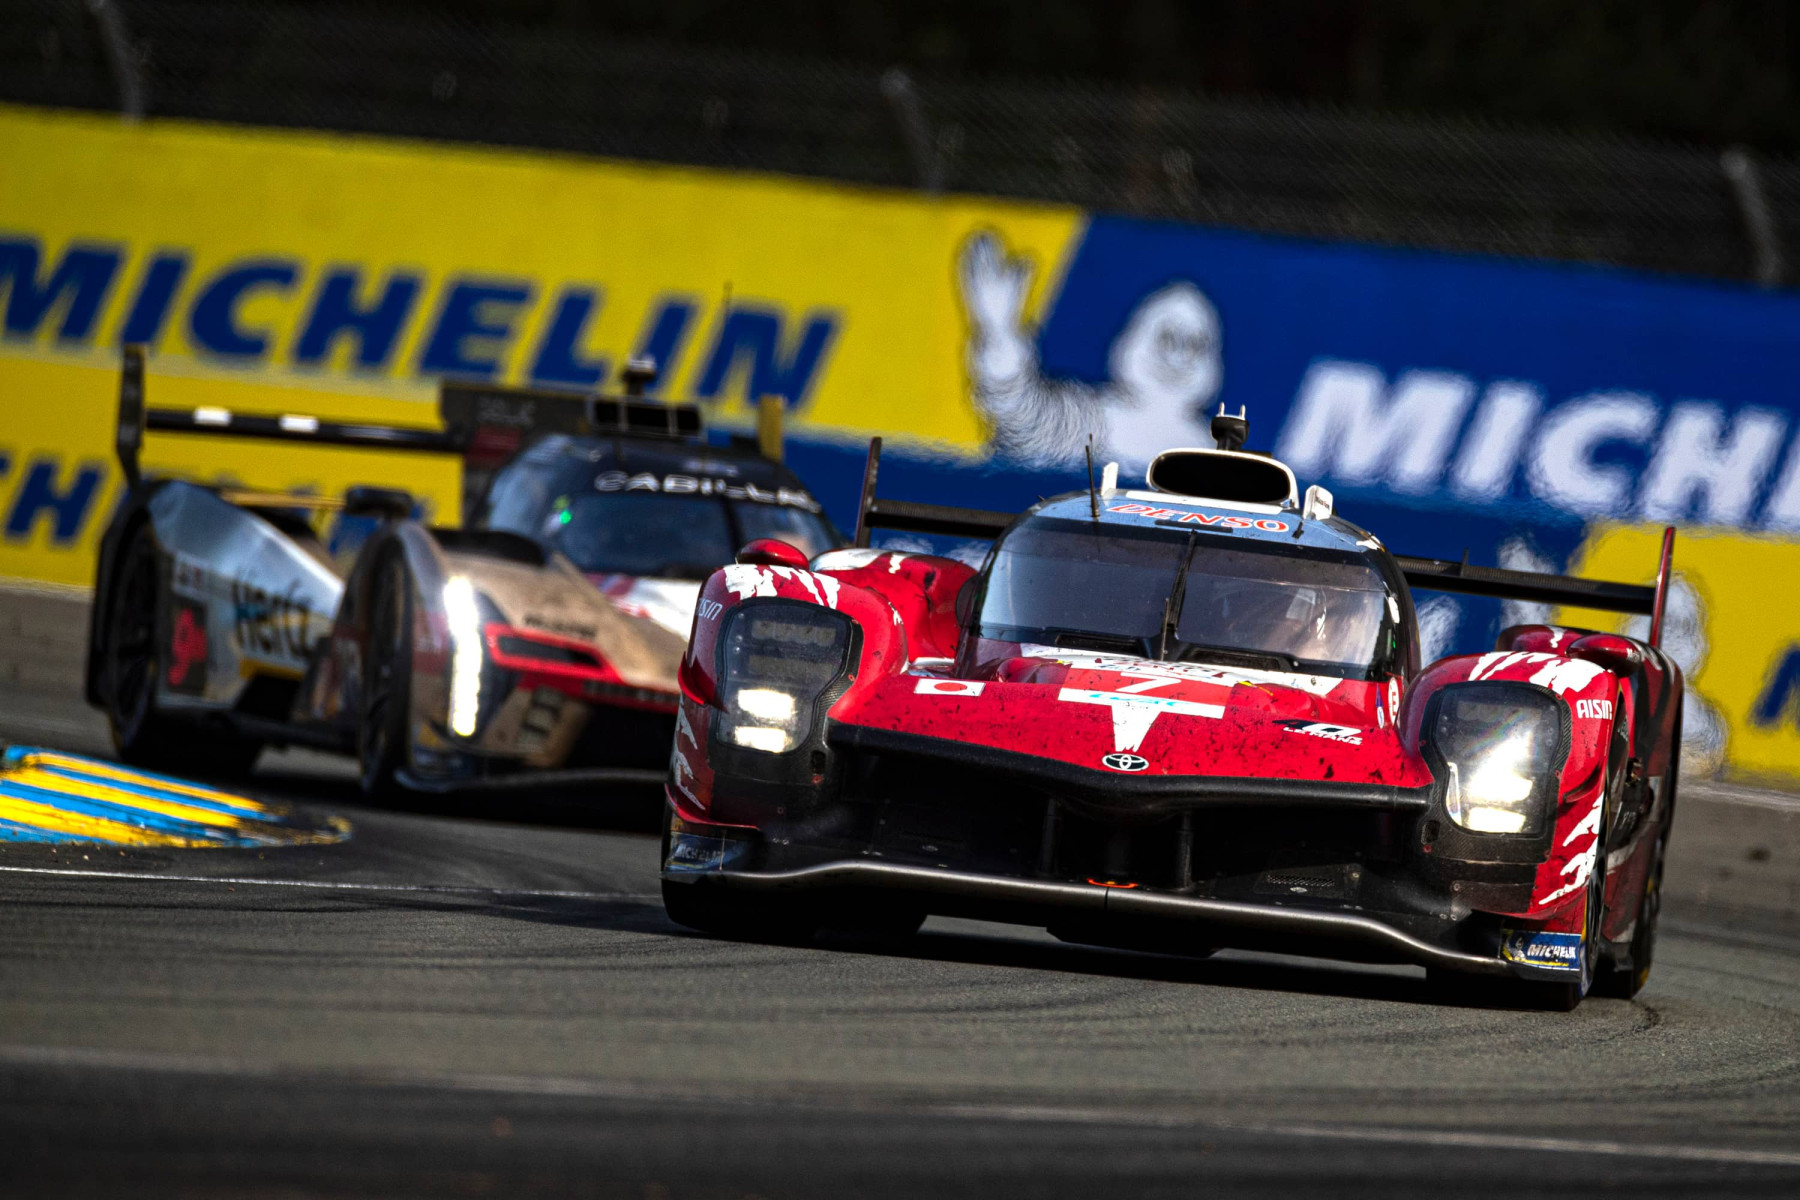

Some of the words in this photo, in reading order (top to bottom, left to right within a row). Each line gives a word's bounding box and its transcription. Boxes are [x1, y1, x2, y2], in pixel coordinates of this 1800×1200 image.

[0, 236, 842, 409] MICHELIN
[1276, 357, 1800, 535] MICH
[1106, 503, 1290, 533] DENSO
[1115, 671, 1182, 694] 7
[1576, 699, 1613, 721] AISIN
